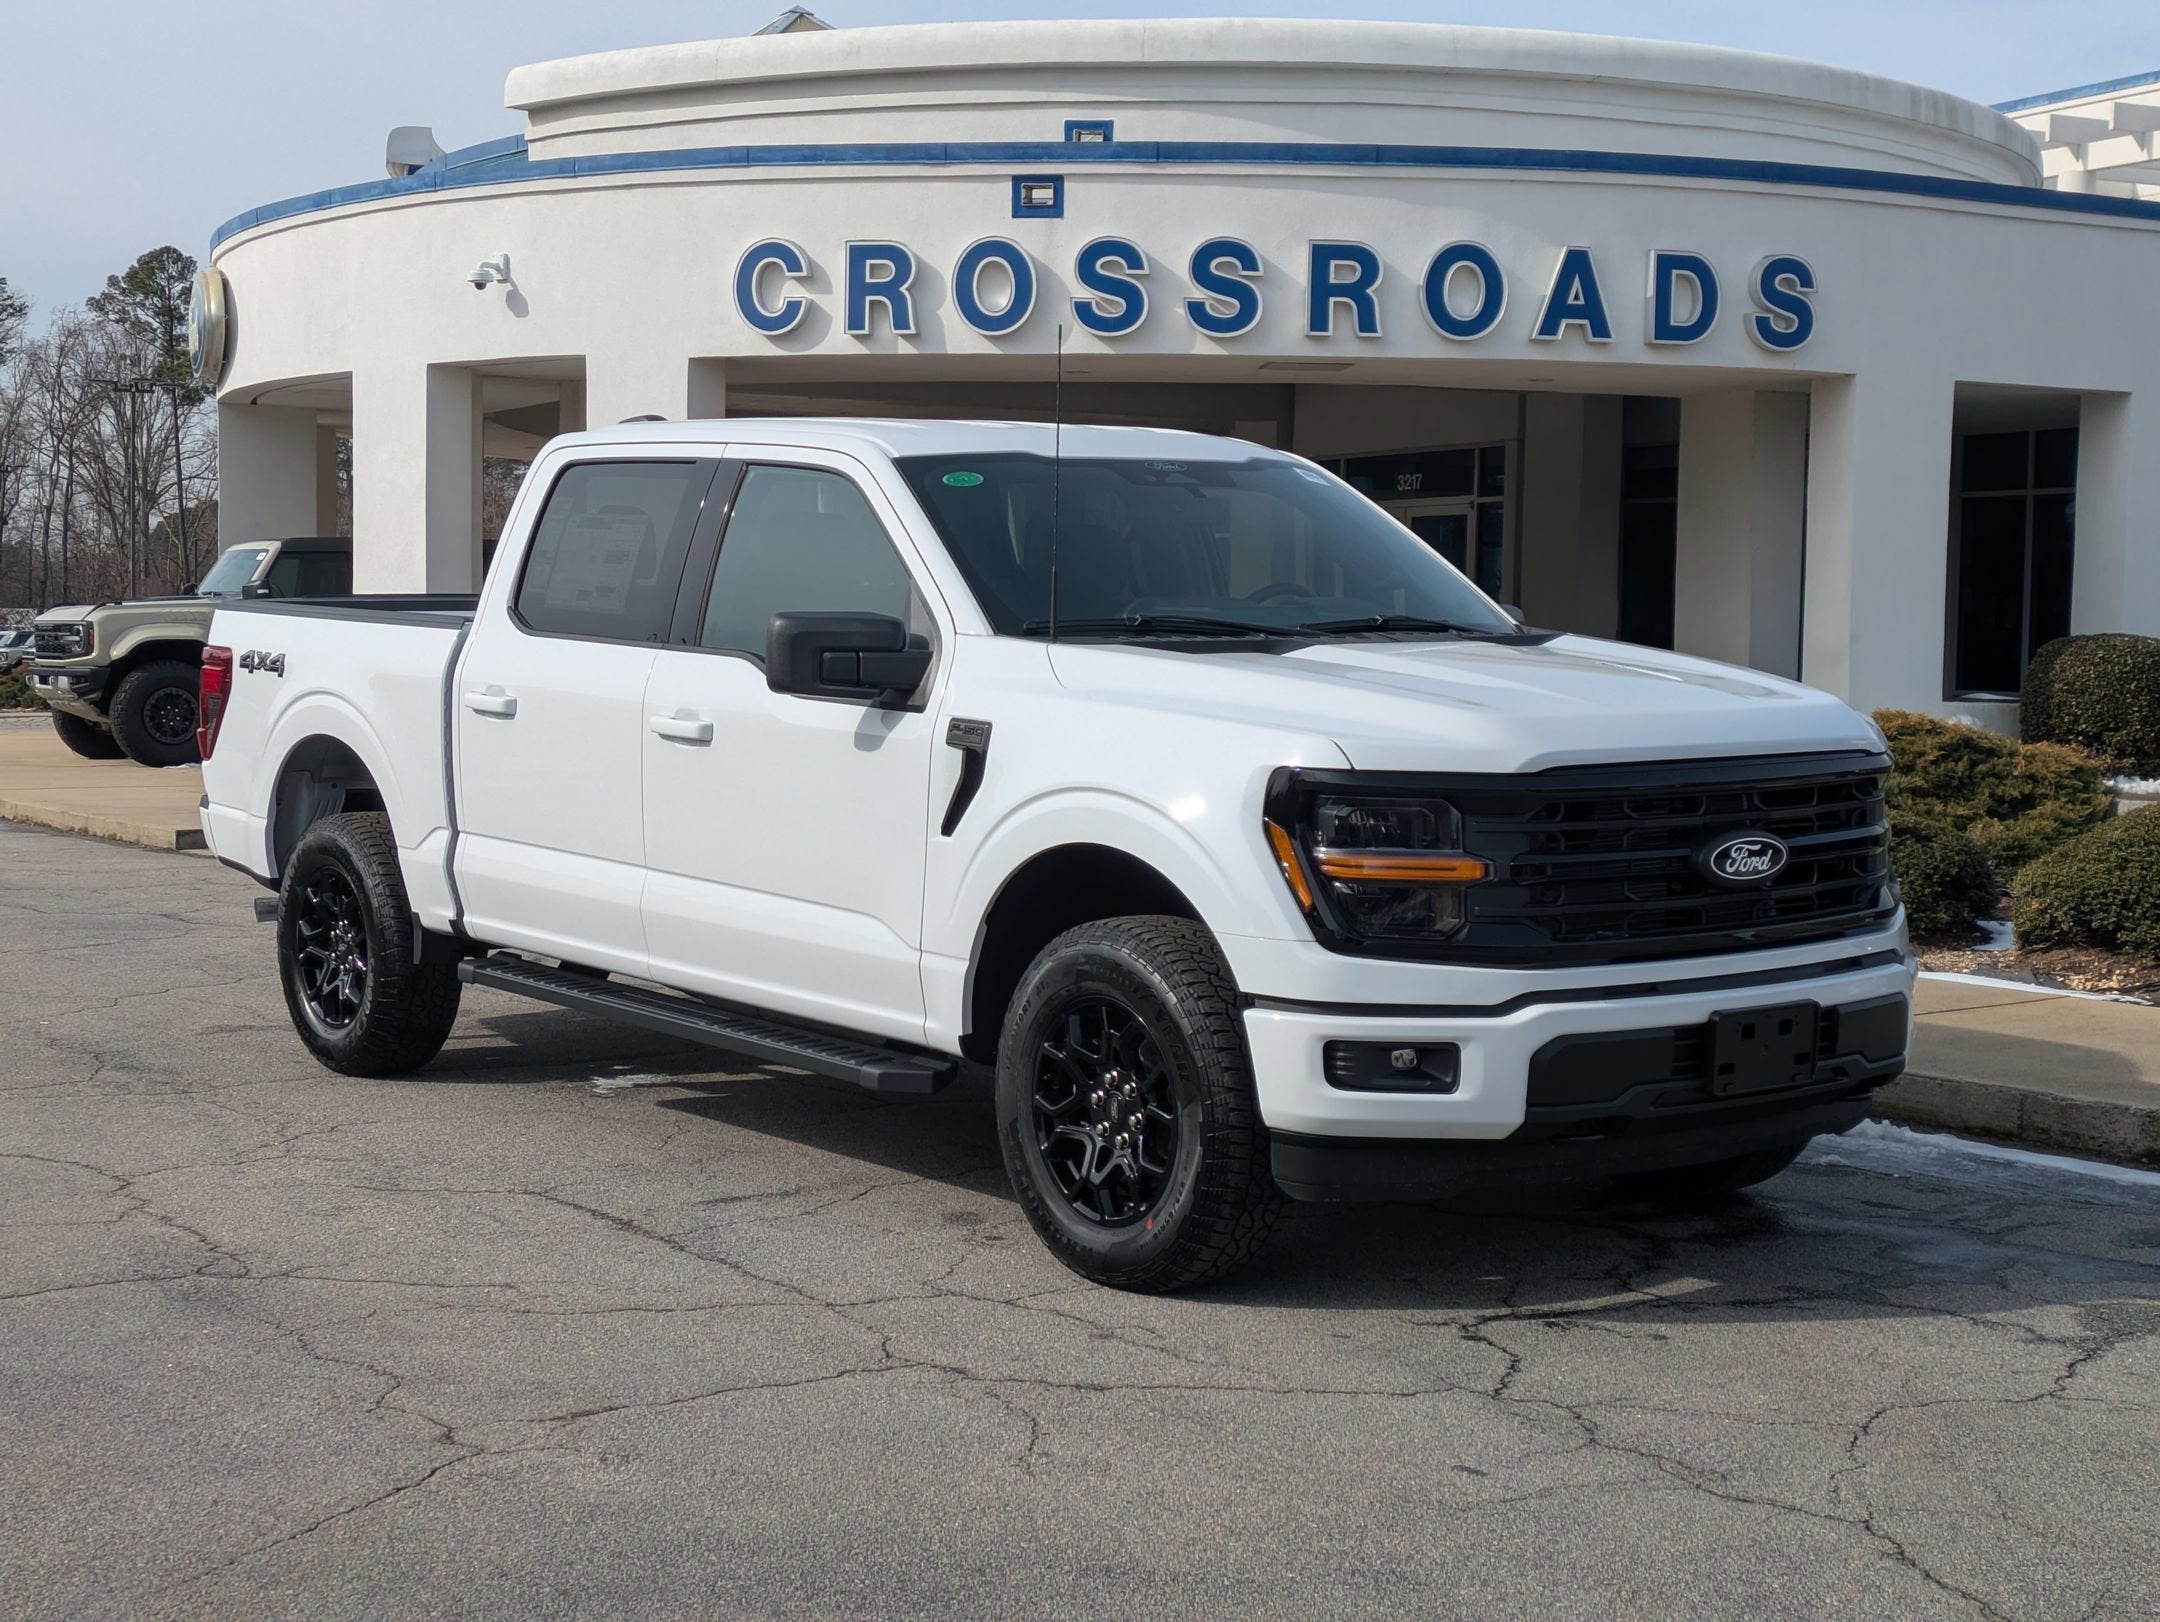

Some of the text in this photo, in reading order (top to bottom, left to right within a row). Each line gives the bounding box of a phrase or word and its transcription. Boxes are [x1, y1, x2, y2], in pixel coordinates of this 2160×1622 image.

[734, 235, 1817, 351] CROSSROADS
[1397, 473, 1423, 491] 3217
[1726, 844, 1773, 873] Ford
